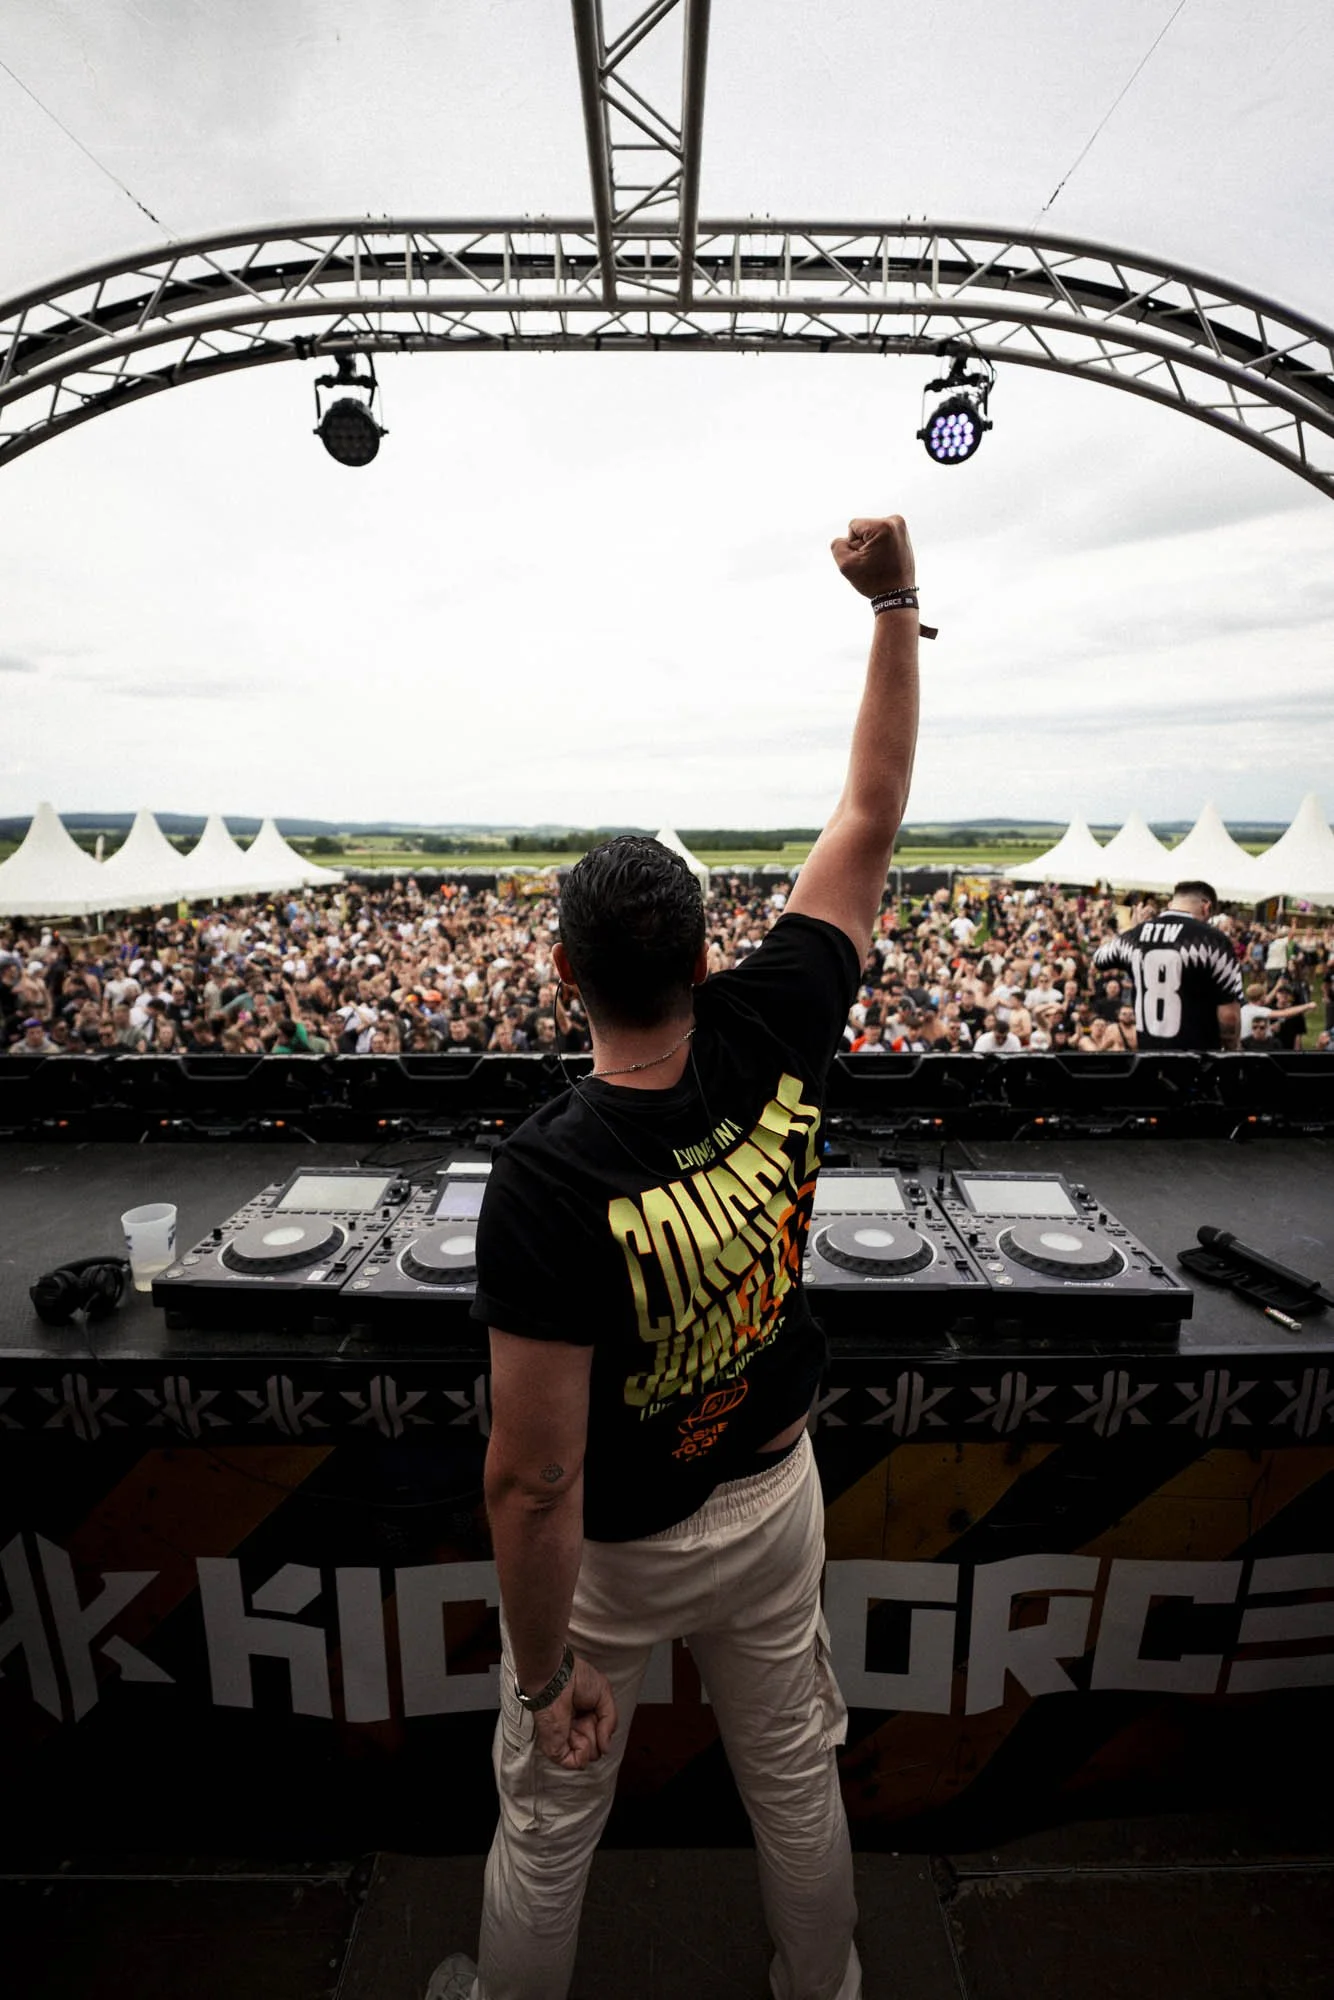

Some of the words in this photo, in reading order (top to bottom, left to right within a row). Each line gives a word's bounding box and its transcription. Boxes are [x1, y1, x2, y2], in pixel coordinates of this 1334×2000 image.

[1139, 922, 1185, 943] RTW
[1131, 948, 1182, 1038] 18
[672, 1136, 716, 1171] LYING
[712, 1121, 737, 1150] IN
[680, 1420, 729, 1448] ASHE
[196, 1553, 1334, 1723] KICORCE
